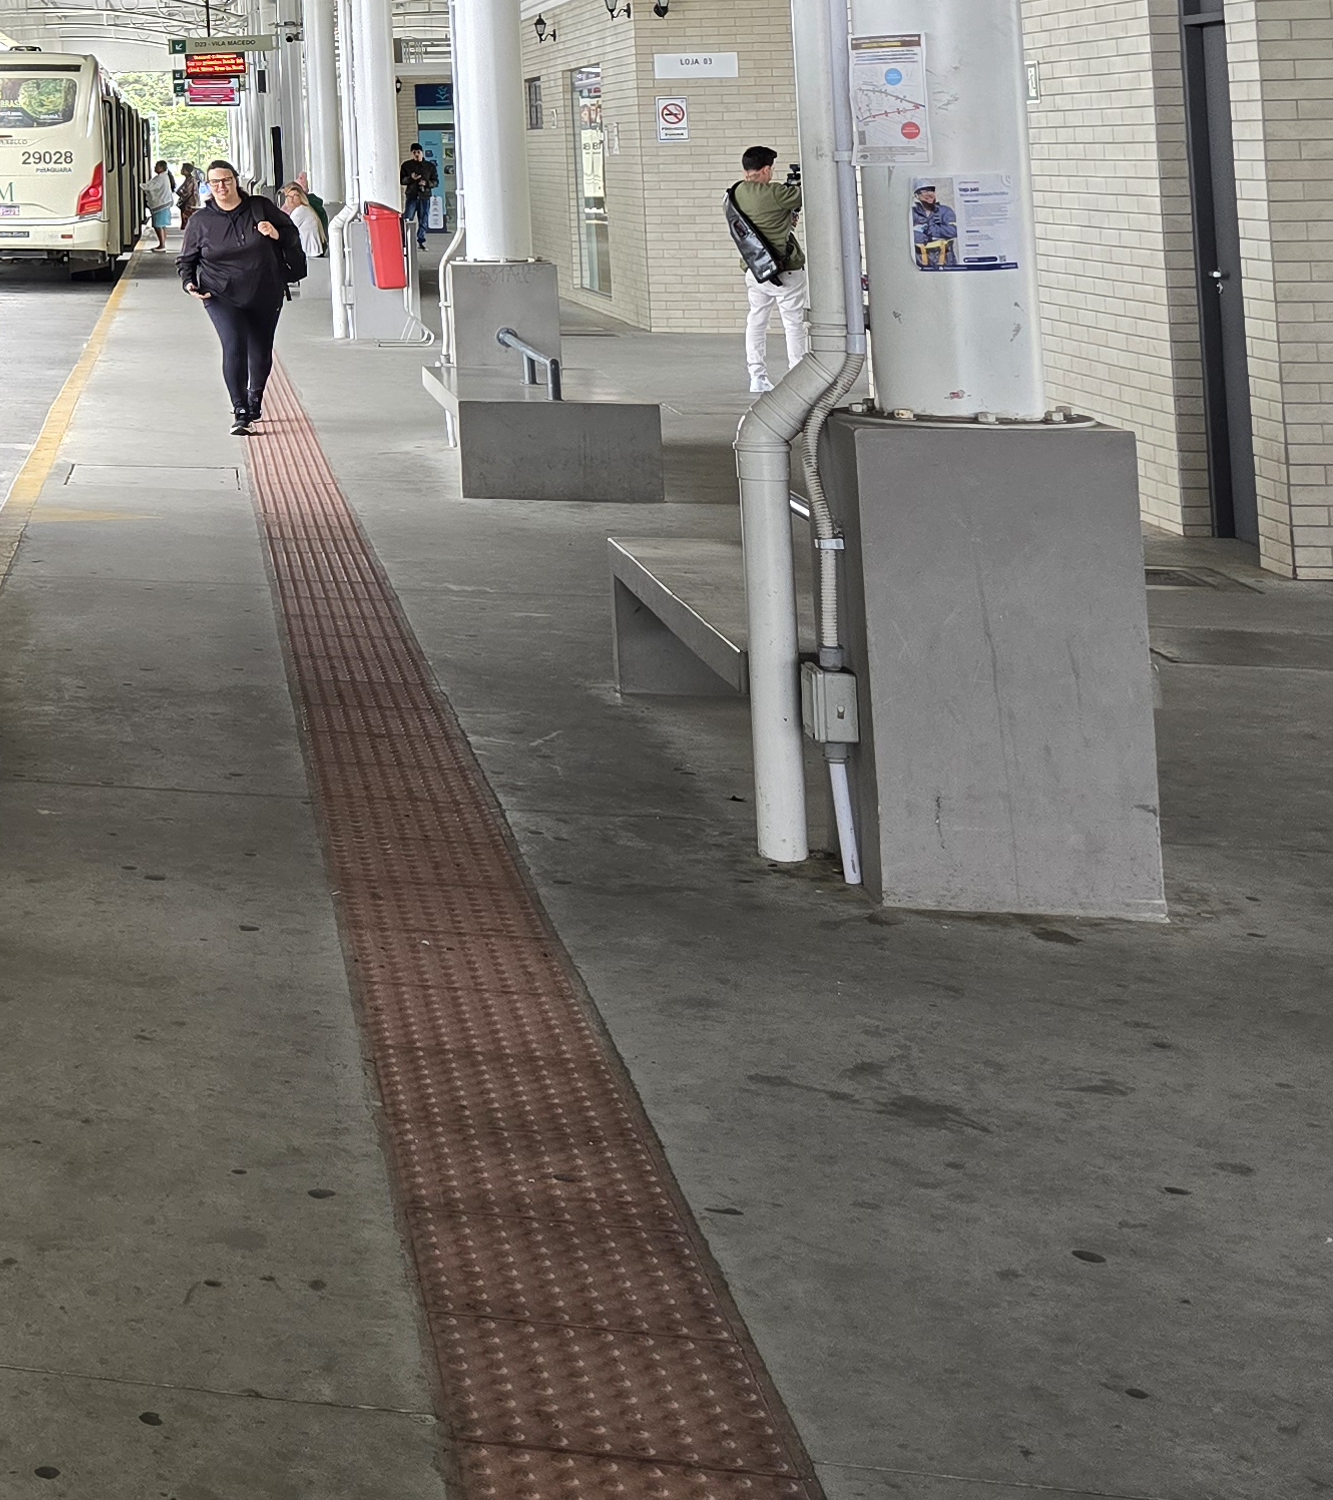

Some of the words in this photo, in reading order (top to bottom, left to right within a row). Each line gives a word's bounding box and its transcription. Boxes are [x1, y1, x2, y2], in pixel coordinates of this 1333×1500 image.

[679, 58, 700, 66] LOJA
[703, 57, 713, 65] 03
[21, 150, 74, 165] 29028
